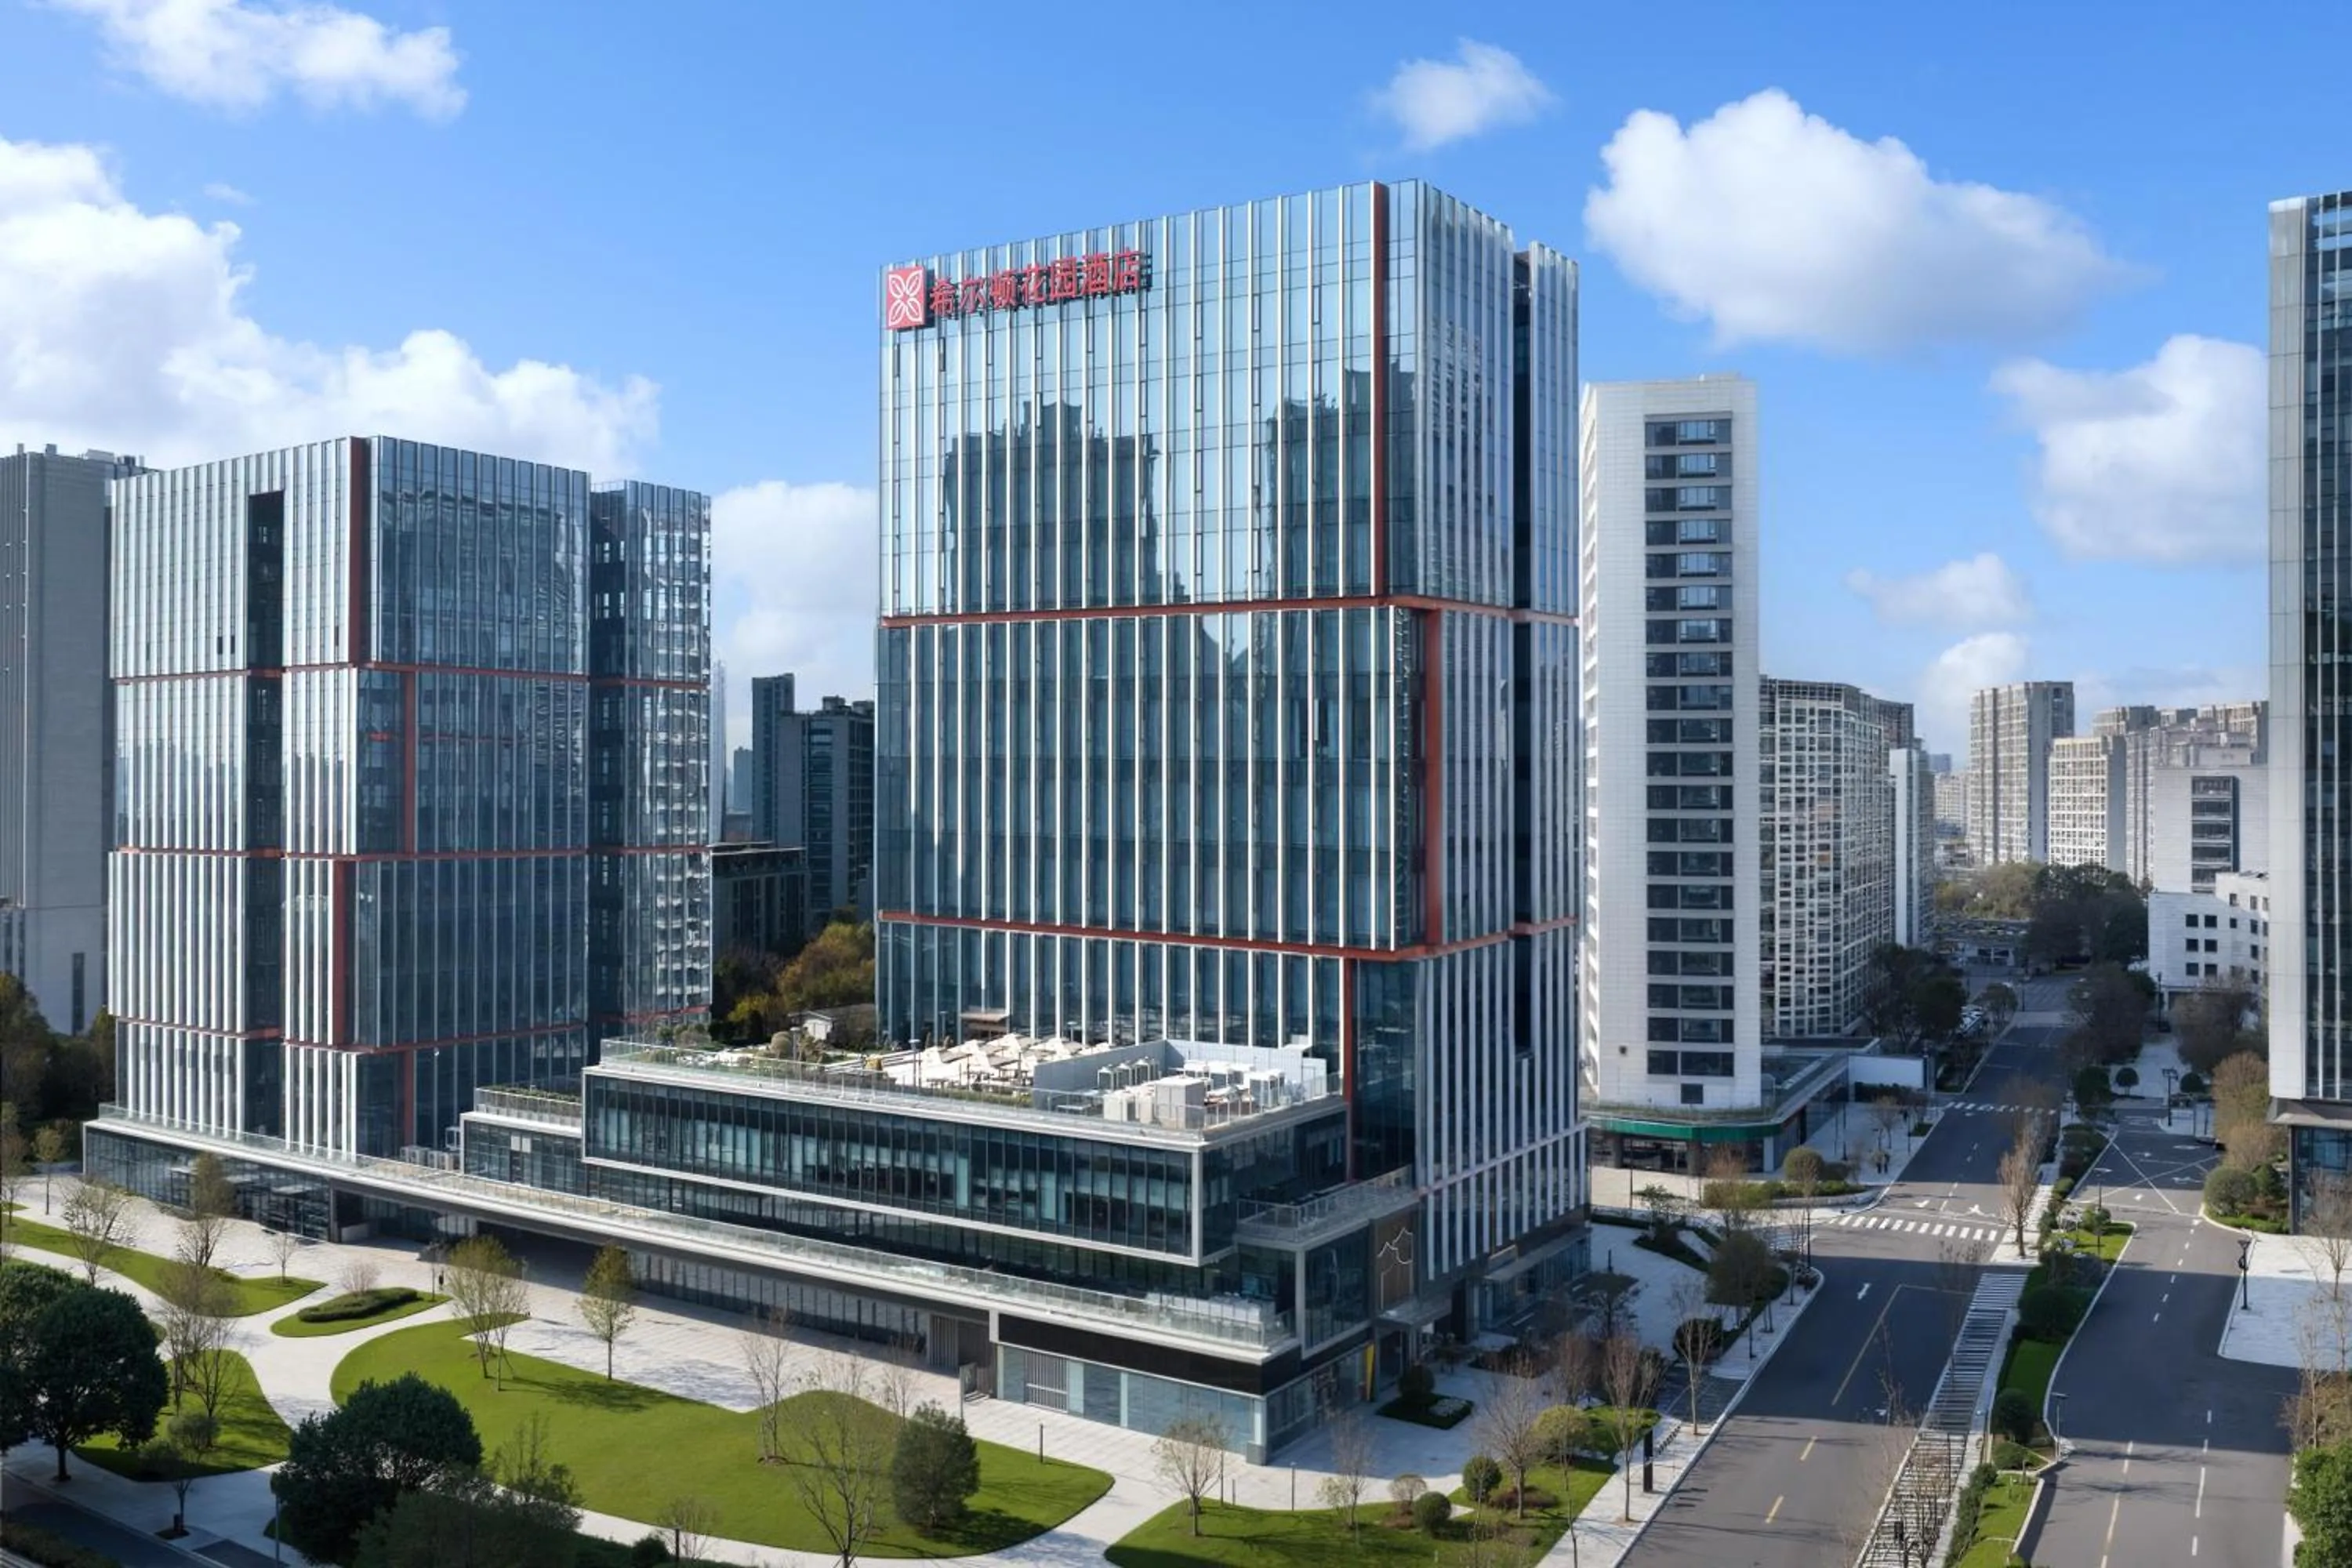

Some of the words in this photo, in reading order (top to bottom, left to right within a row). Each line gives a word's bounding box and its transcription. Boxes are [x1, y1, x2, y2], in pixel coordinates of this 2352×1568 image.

[930, 246, 1142, 315] 希尔顿花园酒店
